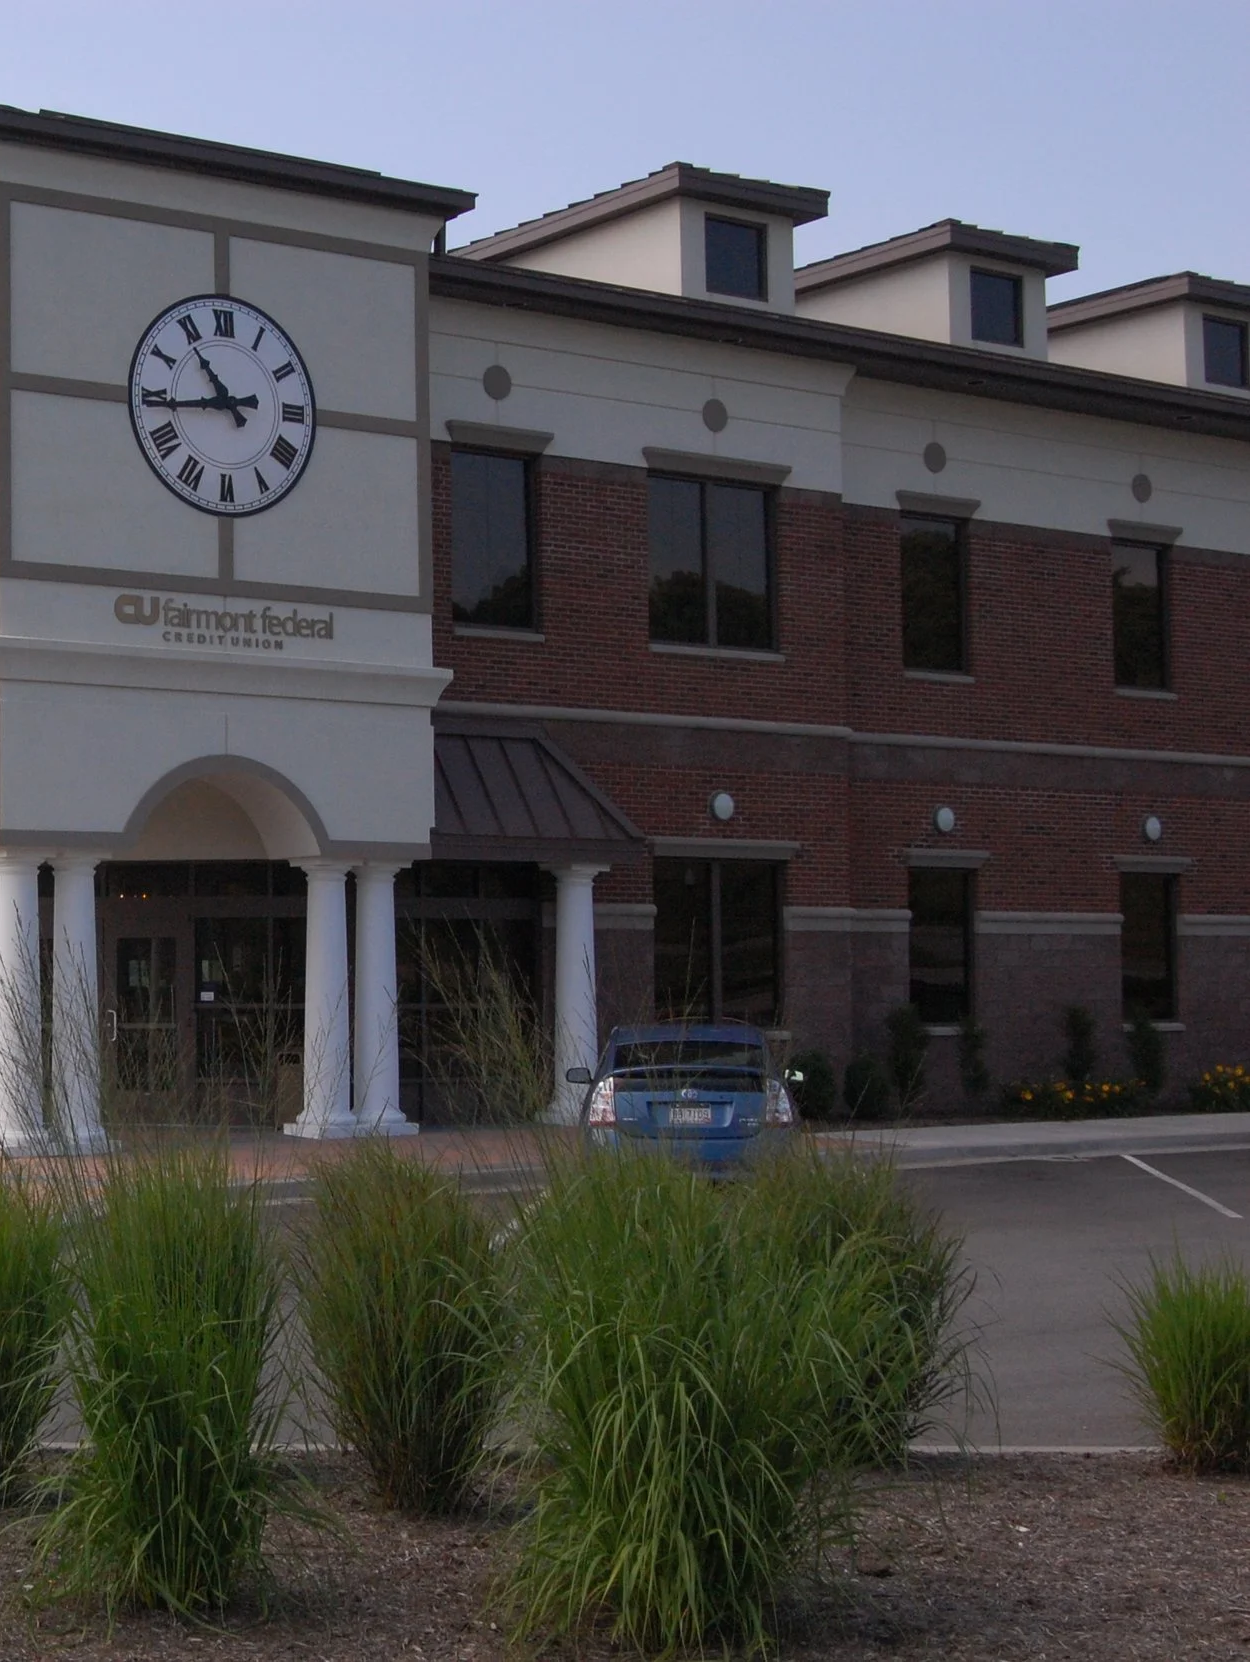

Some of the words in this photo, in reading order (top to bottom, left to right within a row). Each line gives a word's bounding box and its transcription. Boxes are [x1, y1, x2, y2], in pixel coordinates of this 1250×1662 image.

[176, 314, 203, 345] XI
[212, 309, 235, 338] XII
[251, 326, 266, 352] I
[150, 344, 177, 370] X
[272, 360, 296, 383] II
[282, 402, 304, 425] III
[177, 454, 205, 492] VII
[254, 466, 270, 494] V
[219, 473, 235, 503] VI
[114, 594, 160, 626] CU
[162, 599, 257, 634] fairmont
[261, 606, 334, 641] federal
[162, 631, 225, 646] CREDIT
[230, 637, 284, 650] UNION
